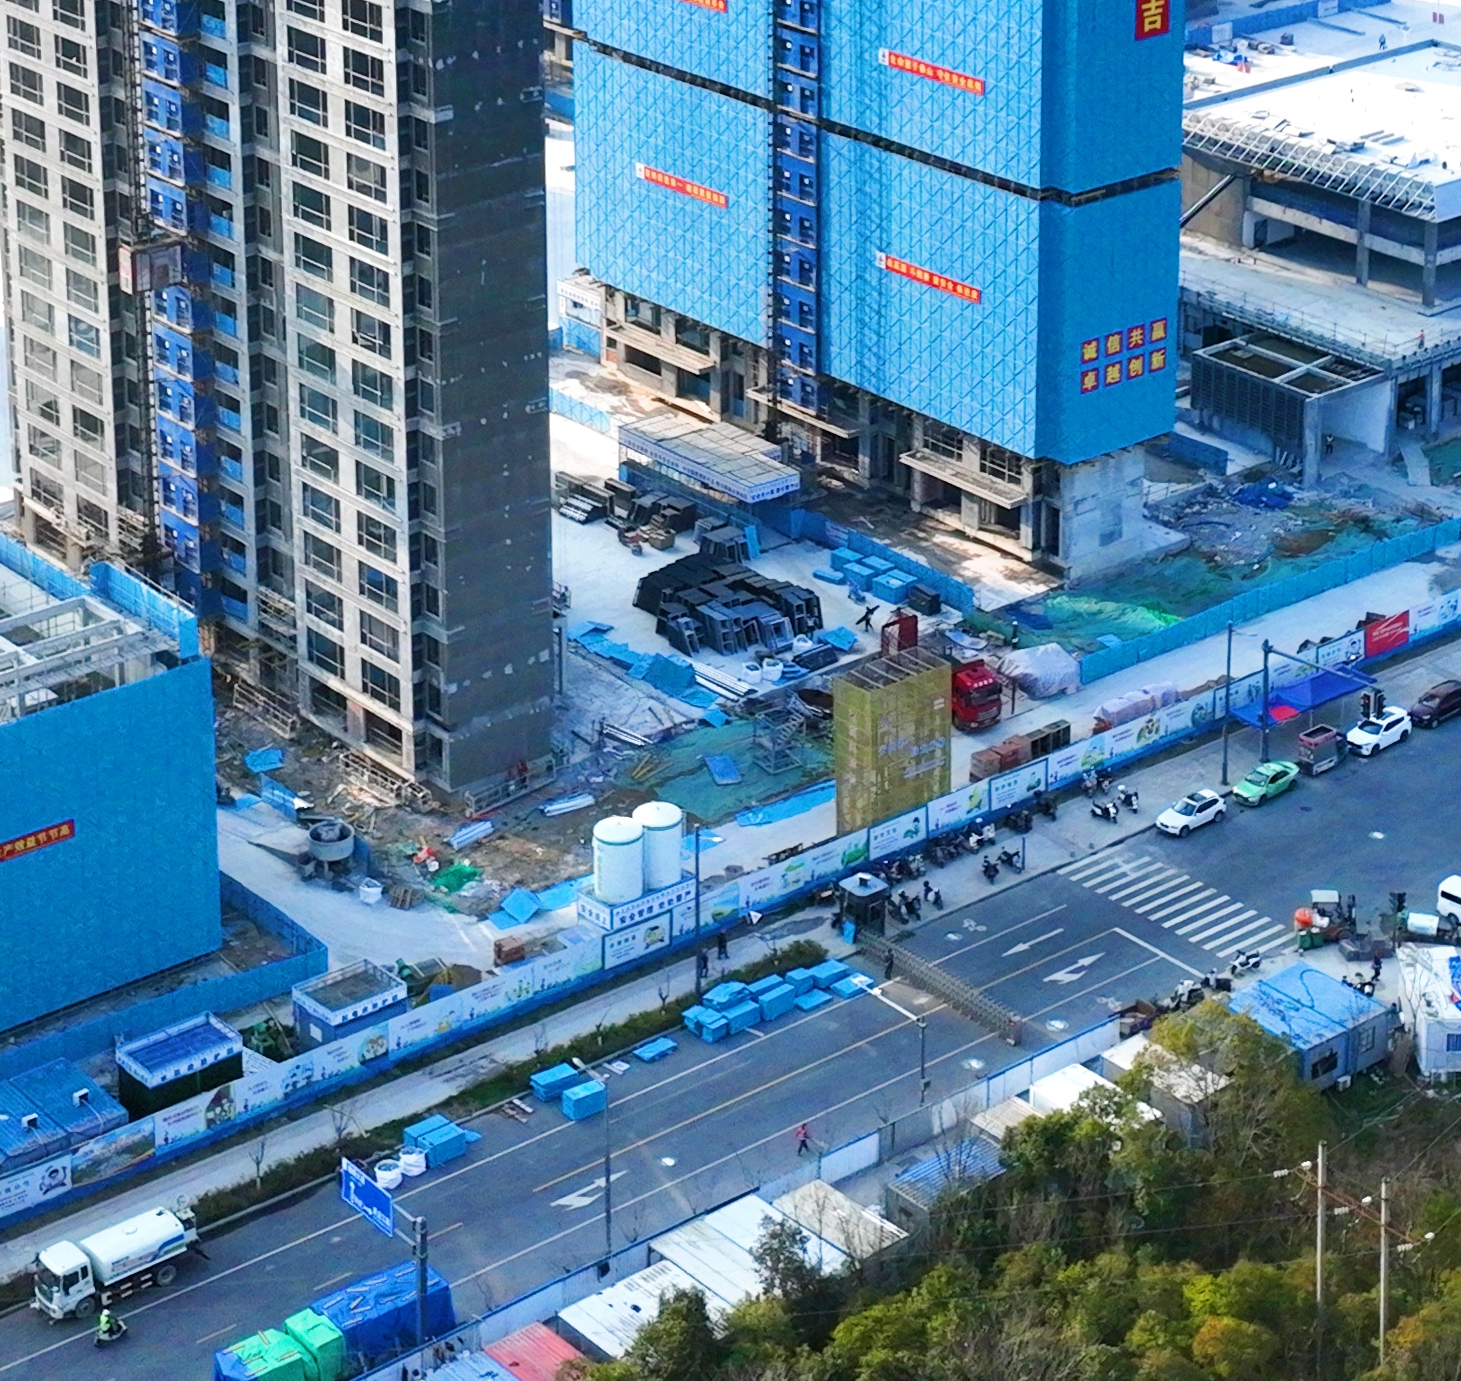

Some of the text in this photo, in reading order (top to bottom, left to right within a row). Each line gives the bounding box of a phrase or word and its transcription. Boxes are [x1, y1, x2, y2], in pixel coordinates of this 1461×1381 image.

[1082, 319, 1166, 361] 诚信共赢
[1082, 349, 1166, 391] 卓越创新
